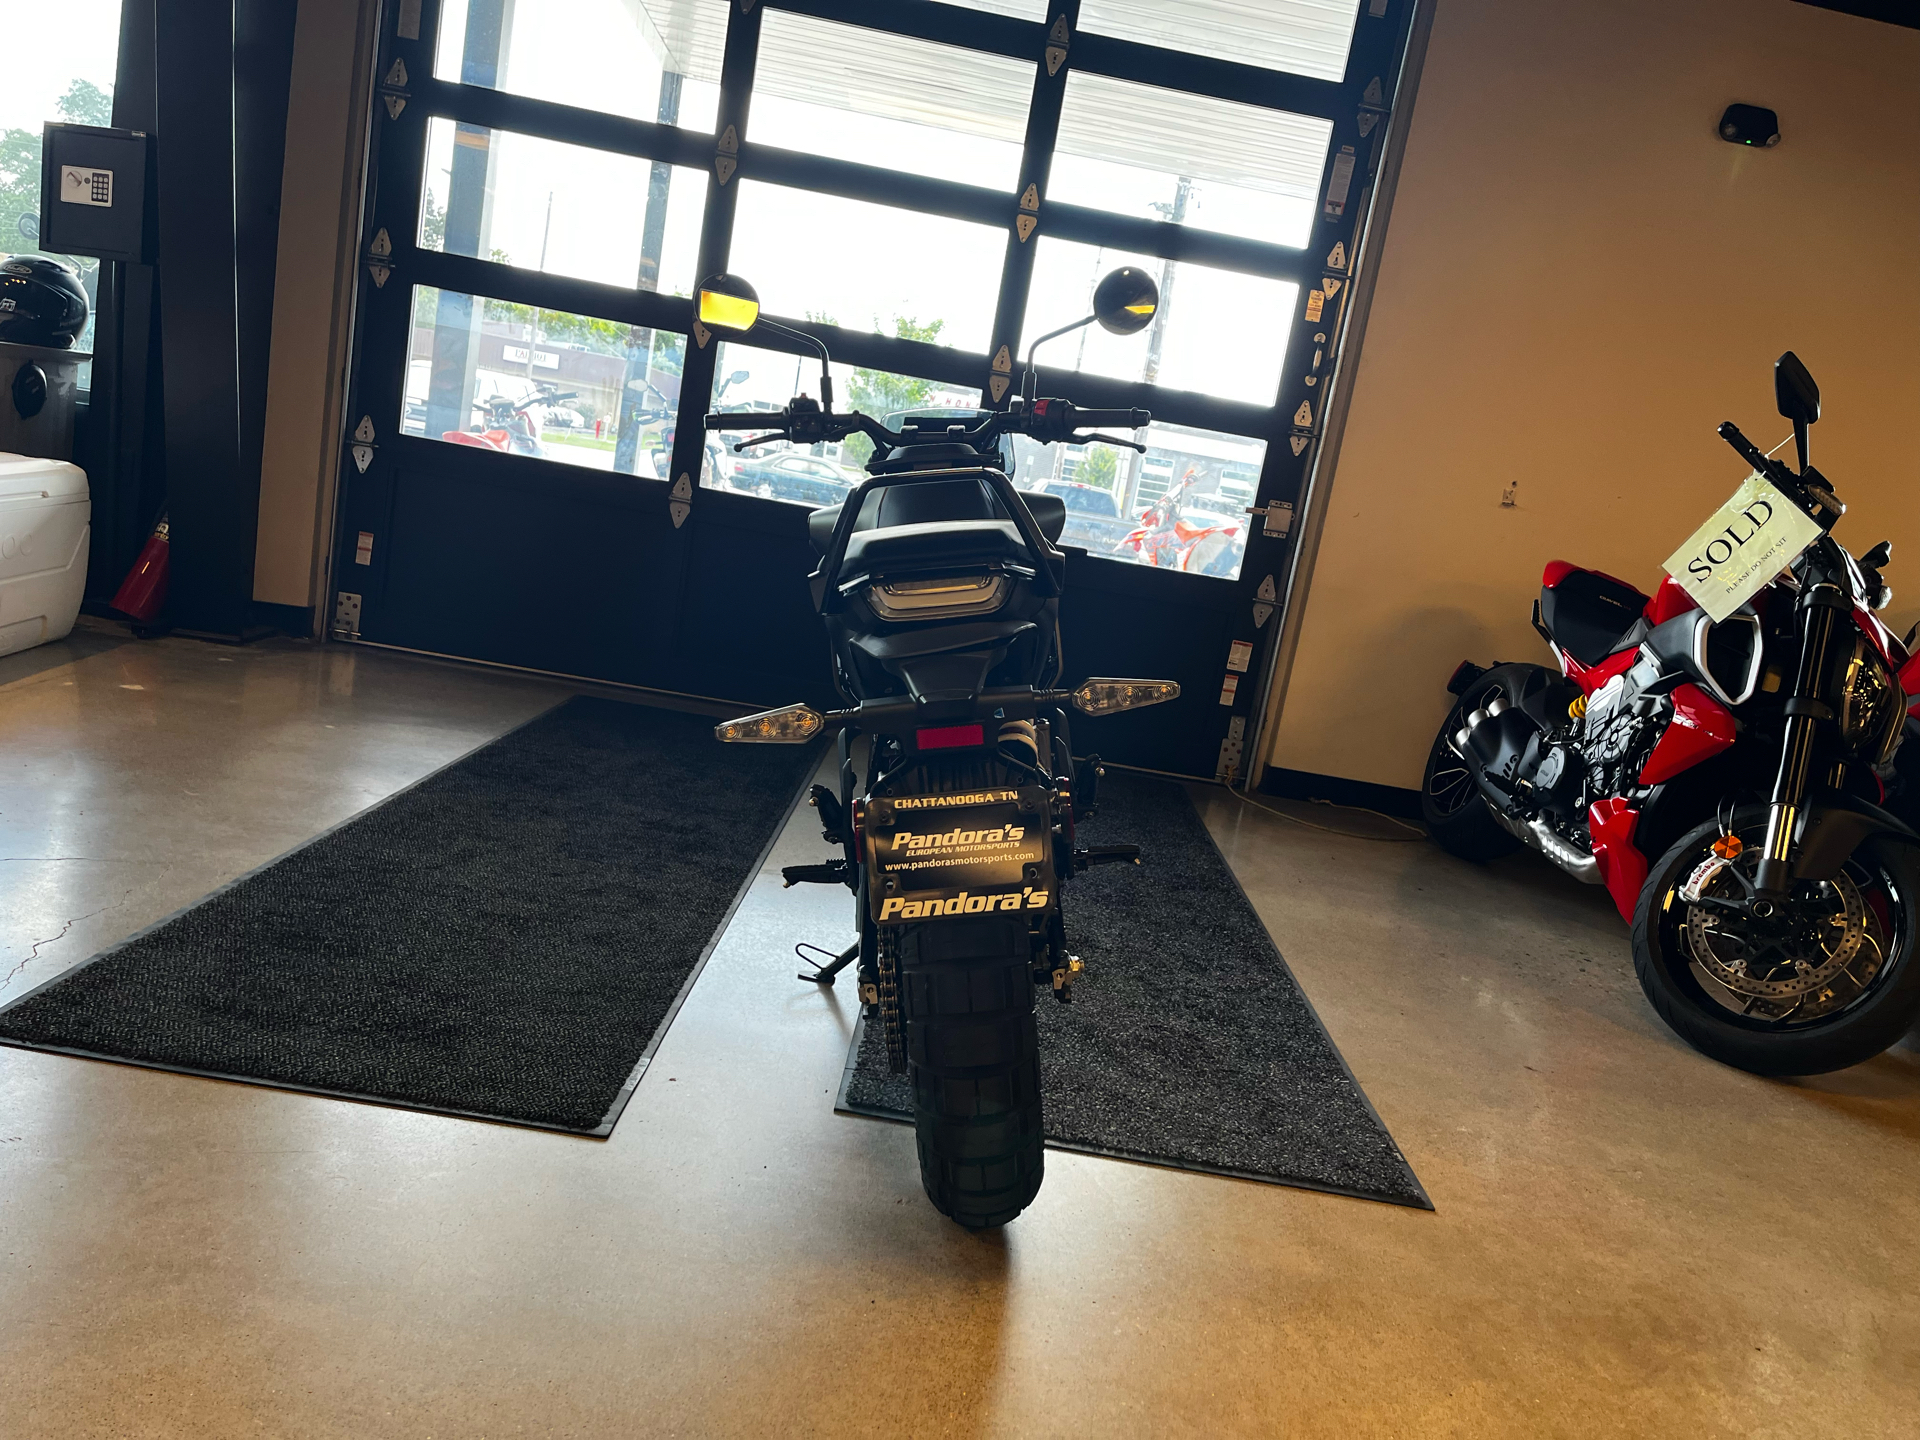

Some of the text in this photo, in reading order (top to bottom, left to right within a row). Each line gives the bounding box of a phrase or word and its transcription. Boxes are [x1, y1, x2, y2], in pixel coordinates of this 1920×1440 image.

[945, 397, 979, 408] HON
[1688, 500, 1773, 583] SOLD
[1725, 536, 1788, 594] PLEASE DO NOT SIT
[894, 790, 1019, 809] CHATTANOOGA TN
[891, 823, 1025, 850] Pandora's
[906, 841, 1021, 857] EUROPEAN MOTORSPORTS
[885, 851, 1035, 871] www.pandorasmotorsports.com
[1692, 862, 1716, 885] brembo
[878, 886, 1049, 921] Pandora's
